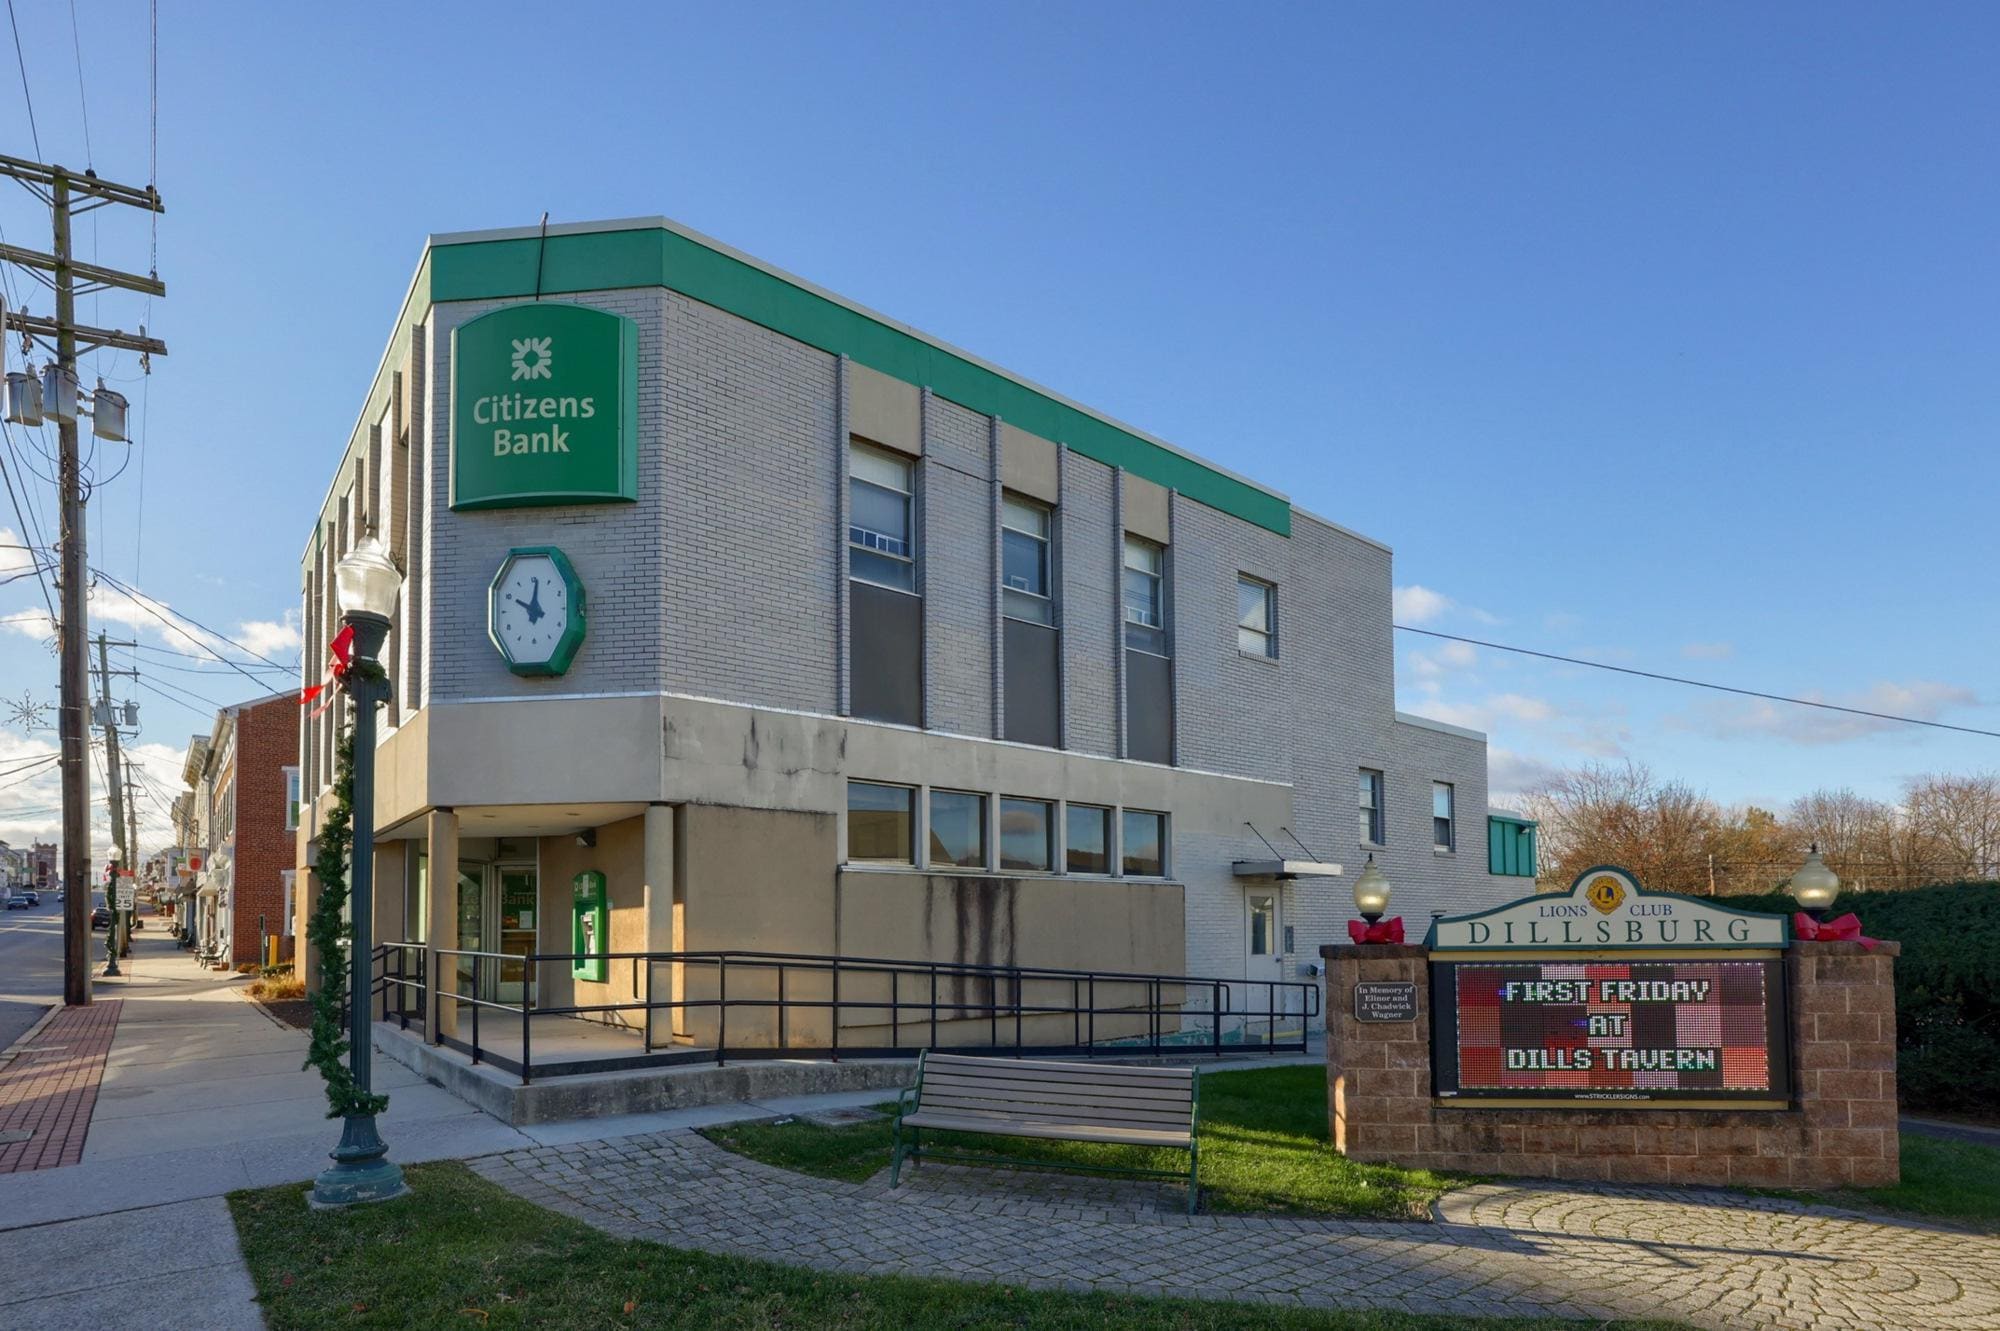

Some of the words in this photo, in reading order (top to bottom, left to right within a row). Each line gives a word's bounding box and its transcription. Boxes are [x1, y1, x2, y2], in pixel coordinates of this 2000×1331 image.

[473, 393, 595, 424] Citizens
[494, 424, 570, 456] Bank
[115, 899, 132, 908] 25
[1540, 905, 1588, 918] LIONS
[1630, 904, 1672, 917] CLUB
[1468, 919, 1750, 944] DILLSBURG
[1370, 987, 1402, 995] Memory
[1506, 981, 1592, 1001] FIRST
[1602, 981, 1709, 1001] FRIDAY
[1371, 1011, 1402, 1019] Wagner
[1589, 1015, 1627, 1036] AT
[1508, 1050, 1592, 1069] DILLS
[1602, 1050, 1715, 1070] TAVERN
